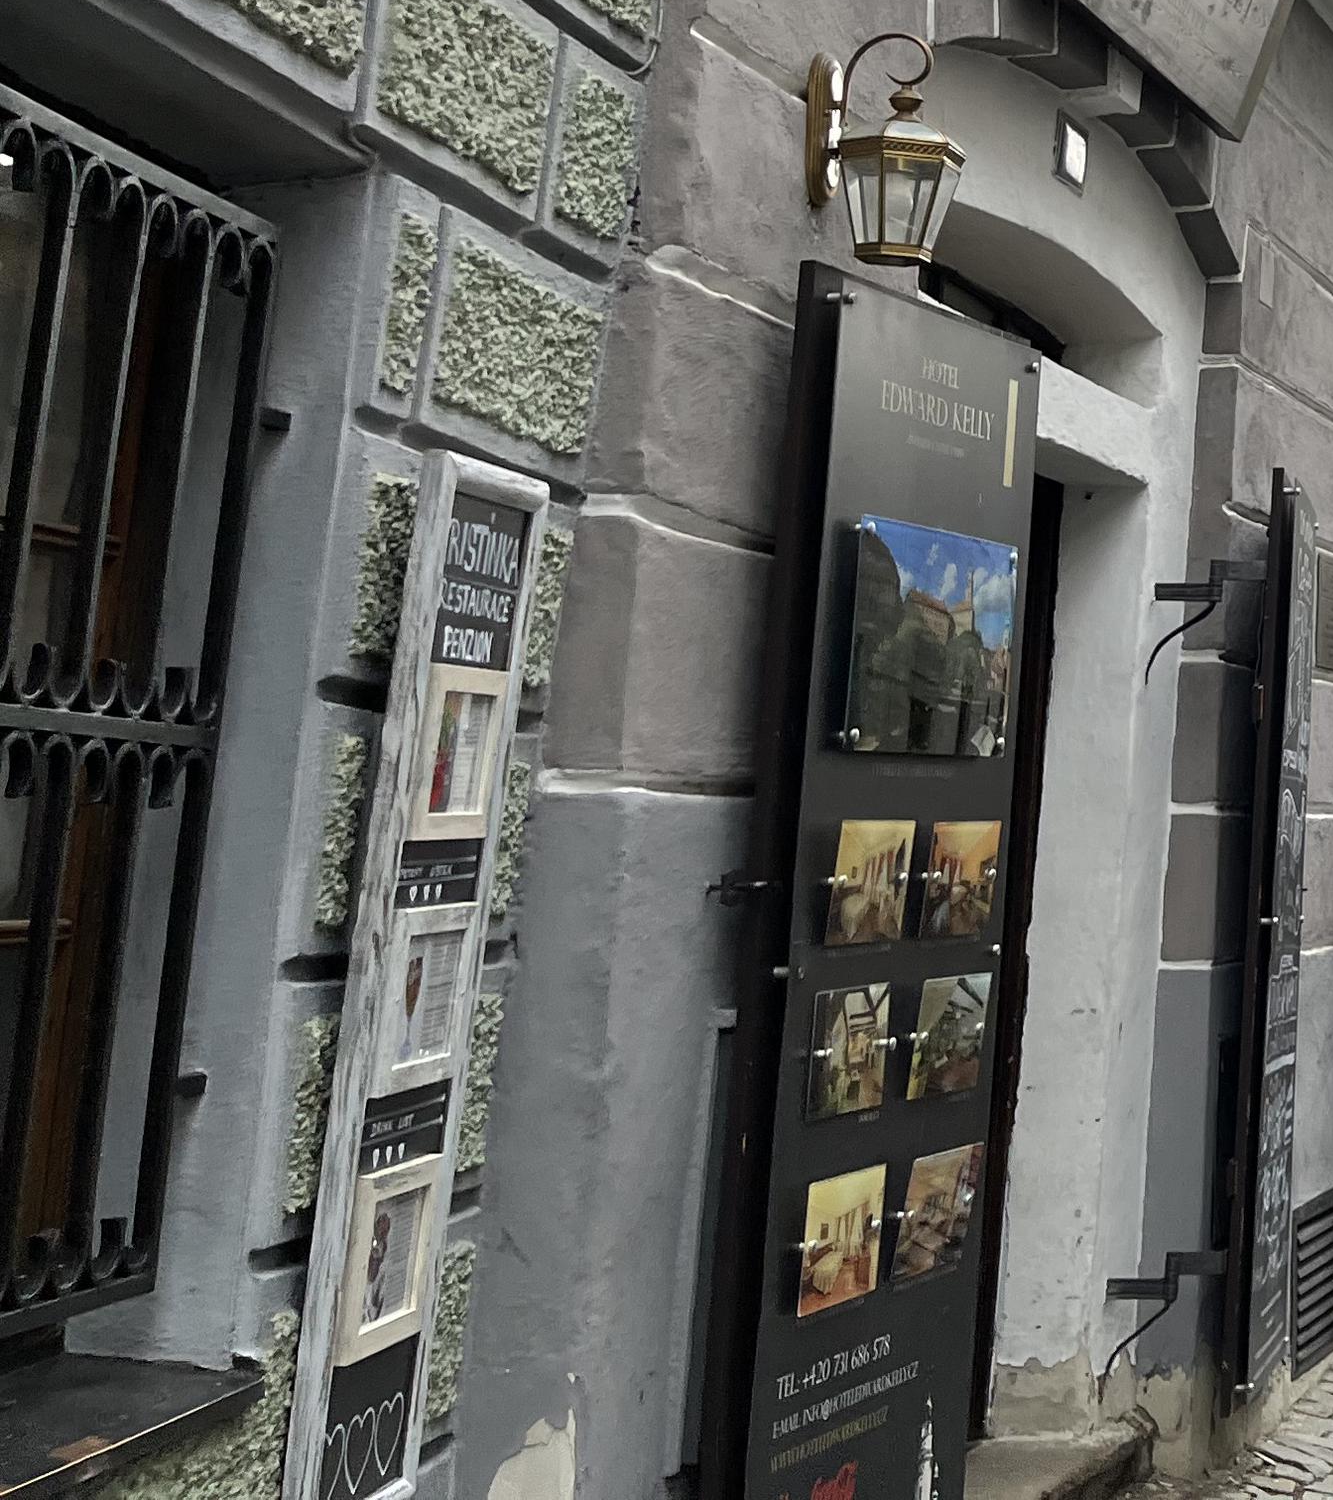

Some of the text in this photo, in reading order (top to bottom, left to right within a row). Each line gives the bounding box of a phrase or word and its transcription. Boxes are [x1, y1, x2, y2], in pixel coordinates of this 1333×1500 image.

[923, 357, 960, 390] HOTEL
[881, 379, 995, 441] EDWARD KELLY
[442, 625, 494, 663] PENZION
[833, 1350, 849, 1377] 731
